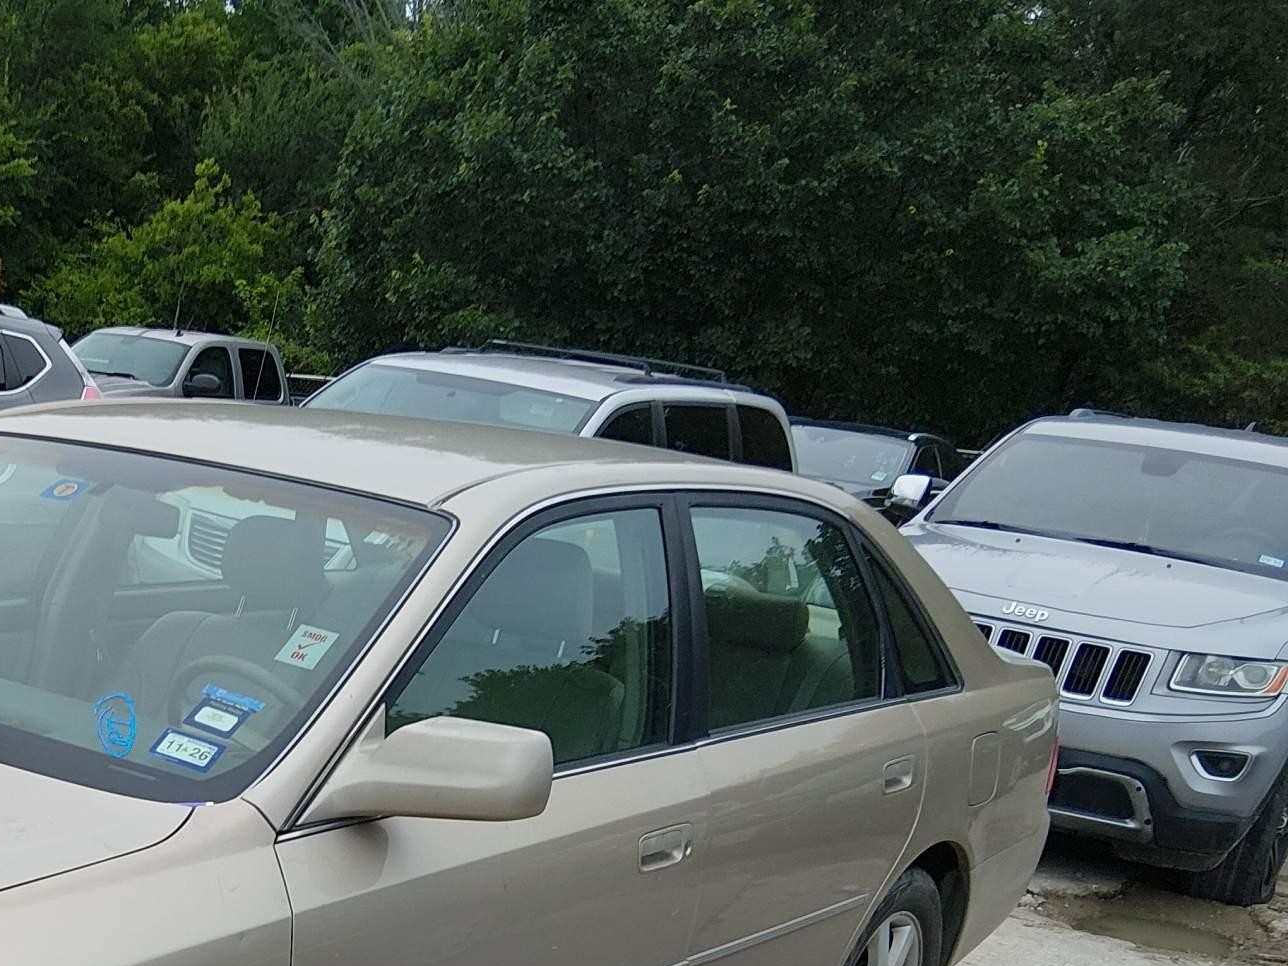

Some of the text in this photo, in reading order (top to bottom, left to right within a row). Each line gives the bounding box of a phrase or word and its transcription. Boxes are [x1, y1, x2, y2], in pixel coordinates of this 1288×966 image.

[1002, 601, 1049, 622] Jeep
[290, 650, 308, 662] OK
[166, 739, 184, 753] 11
[188, 747, 211, 761] 26
